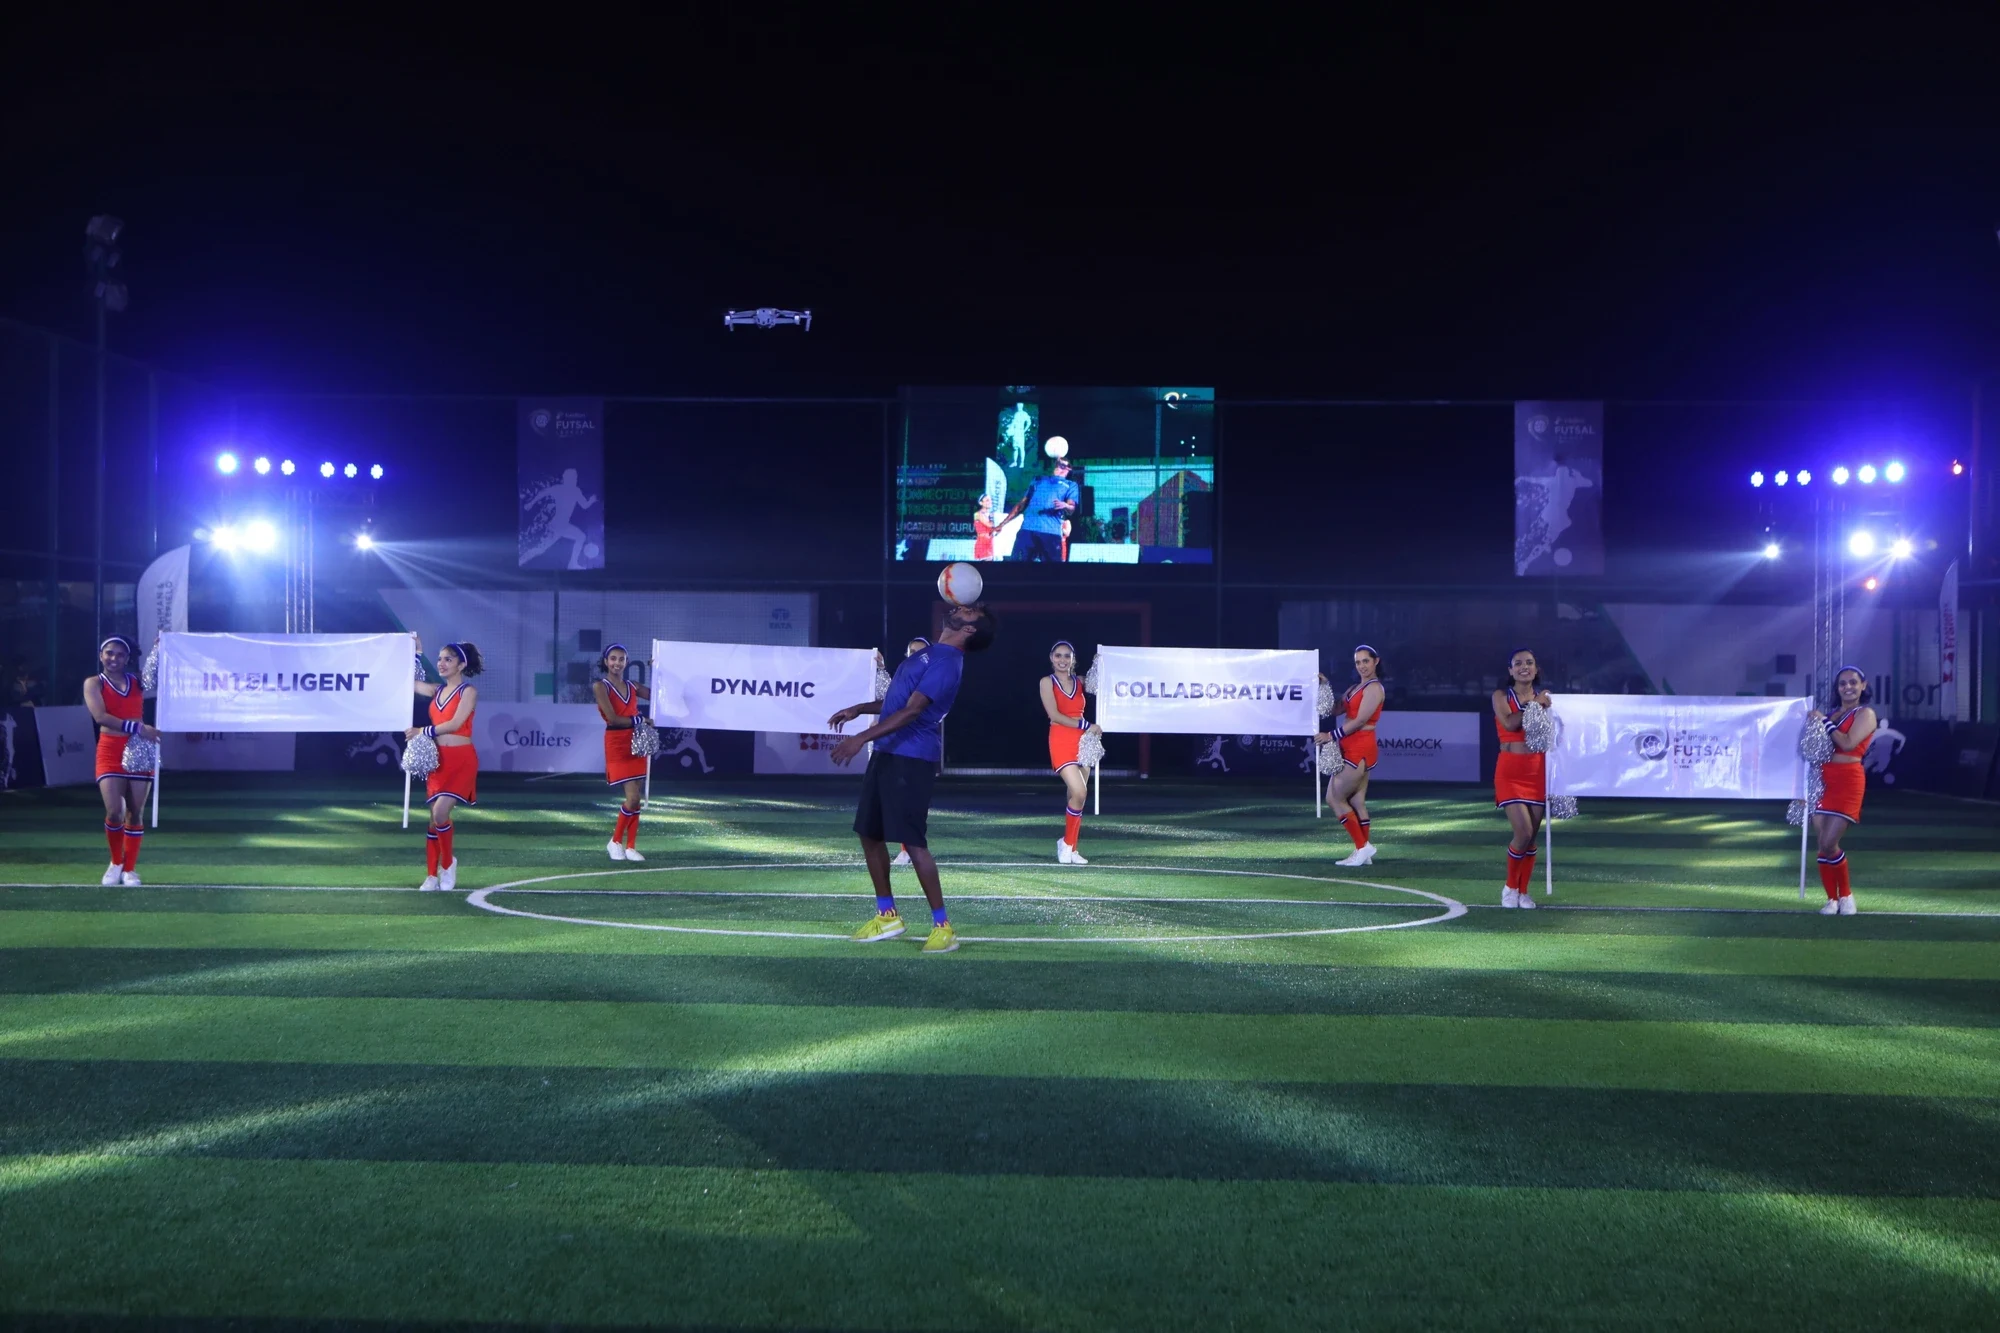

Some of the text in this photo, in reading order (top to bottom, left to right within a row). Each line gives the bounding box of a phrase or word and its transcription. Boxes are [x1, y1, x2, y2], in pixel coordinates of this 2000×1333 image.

[556, 420, 595, 429] FUTSAL
[1554, 425, 1596, 435] FUTSAL
[992, 480, 1001, 512] olliers
[948, 522, 975, 533] GURU
[156, 592, 164, 630] SHMAN
[164, 581, 173, 632] AKEFIELD
[203, 672, 370, 692] INTELLIGENT
[711, 677, 816, 699] DYNAMIC
[1114, 680, 1303, 701] COLLABORATIVE
[504, 729, 572, 748] Colliers
[1259, 739, 1295, 748] FUTSAL
[1376, 738, 1443, 750] ANAROCK
[1673, 745, 1733, 758] FUTSAL
